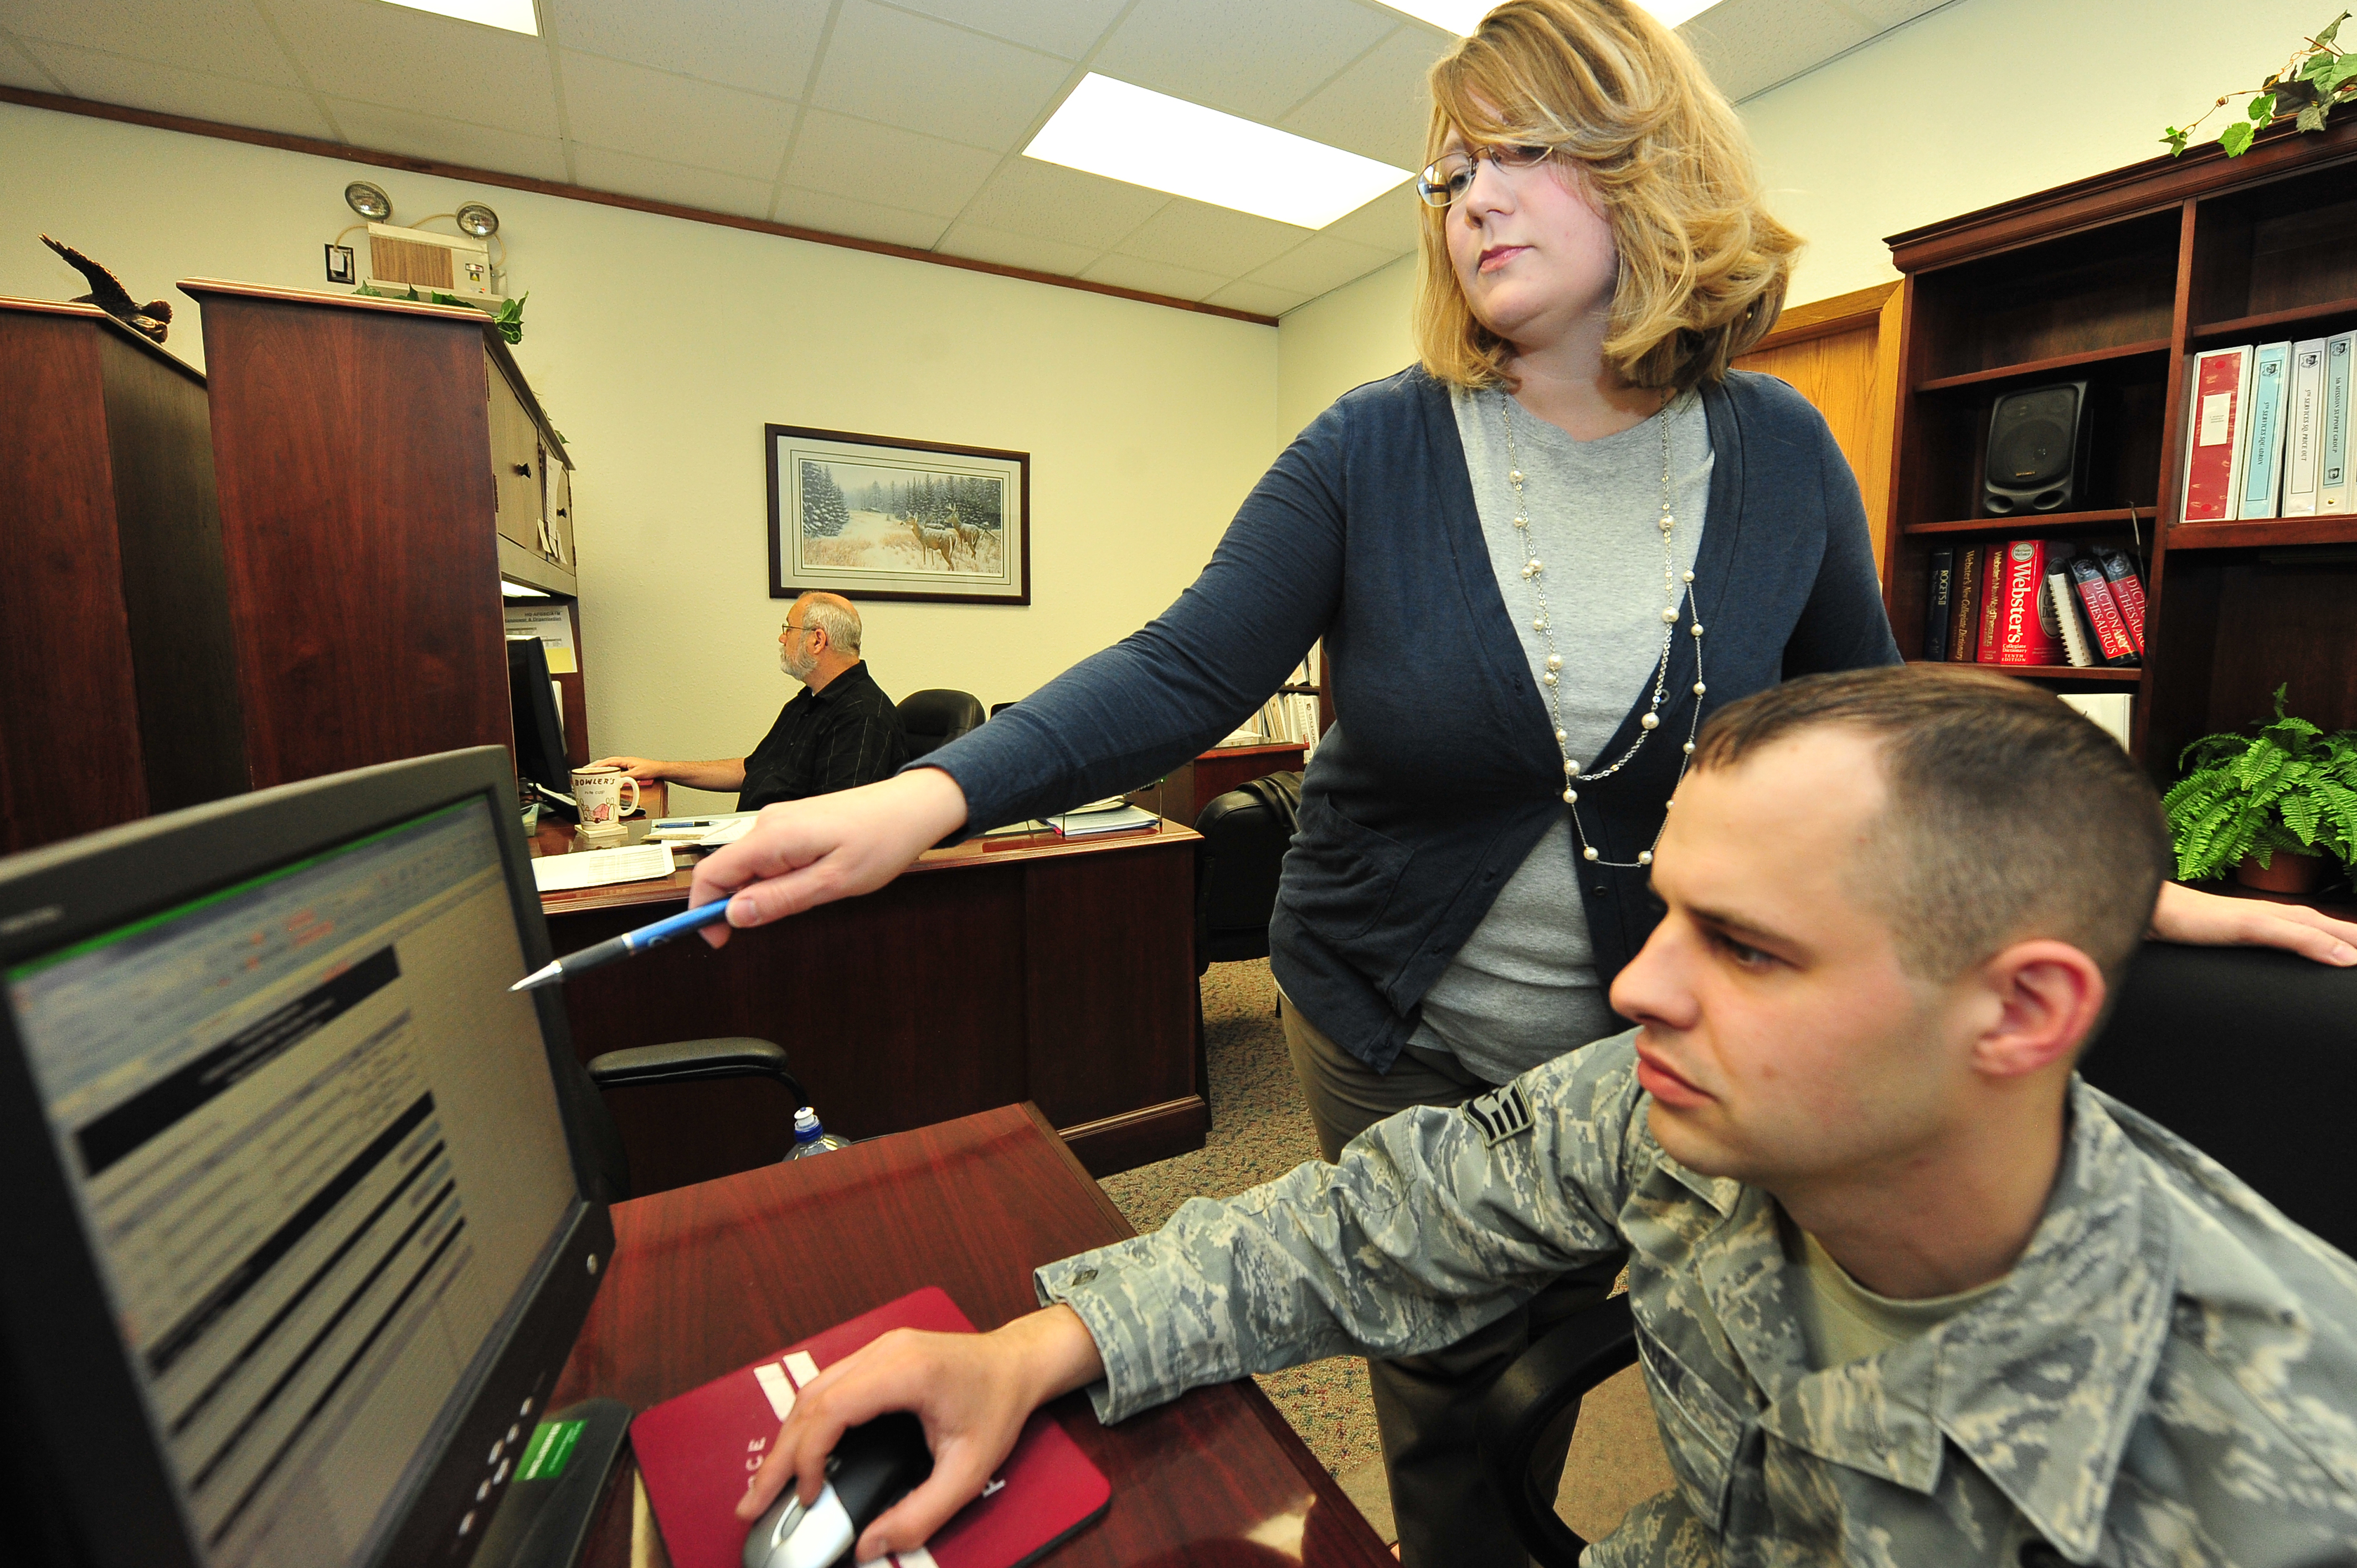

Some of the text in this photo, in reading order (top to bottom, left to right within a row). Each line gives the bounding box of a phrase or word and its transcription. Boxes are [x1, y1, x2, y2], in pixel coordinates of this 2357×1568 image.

[1963, 550, 1975, 586] Webster's
[1993, 550, 2003, 582] Webster's
[1958, 599, 1970, 629] Collegiate
[2008, 561, 2032, 643] Webster's
[2093, 581, 2130, 649] DICTIONARY
[2085, 592, 2118, 655] THESAURUS
[1955, 630, 1968, 661] Dictionary
[575, 777, 615, 786] BOWLER'S
